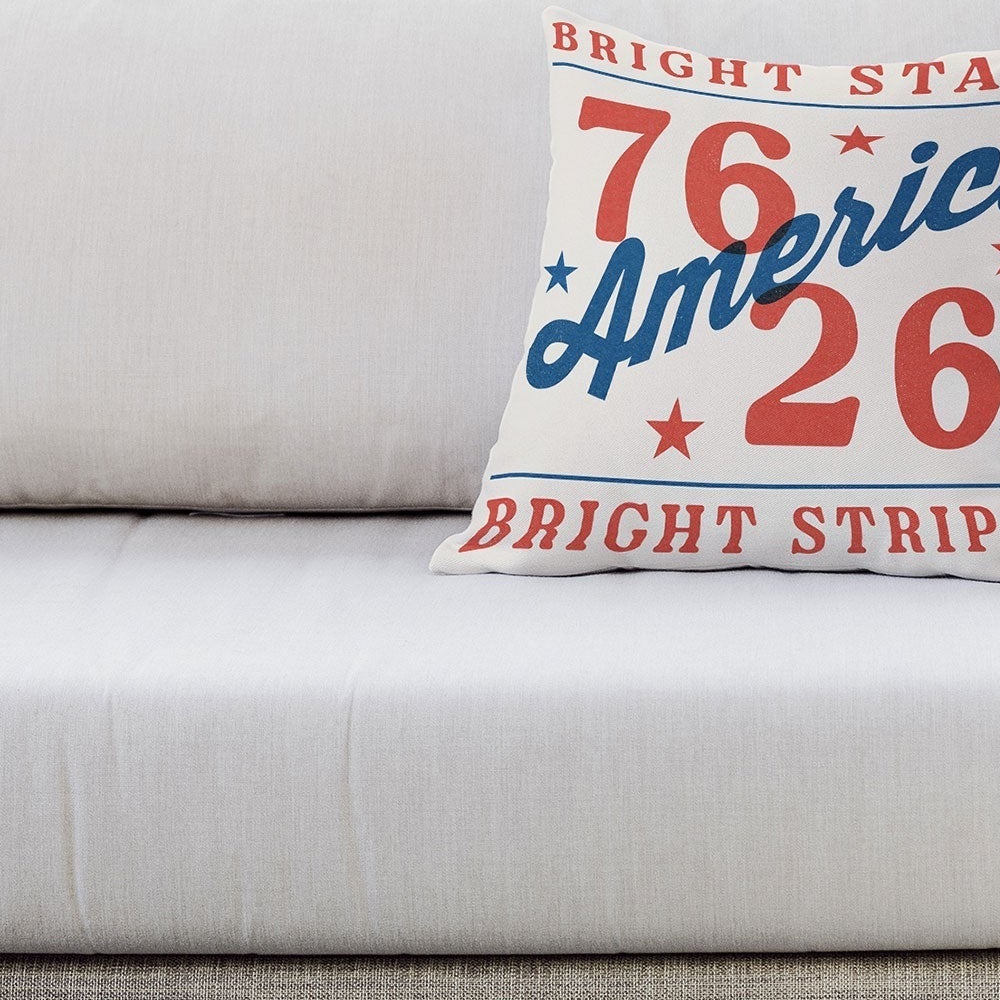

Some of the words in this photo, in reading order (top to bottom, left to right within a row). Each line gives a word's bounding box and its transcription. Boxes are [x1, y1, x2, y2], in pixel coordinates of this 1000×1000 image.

[552, 21, 802, 92] BRIGHT
[577, 95, 797, 255] 76
[458, 497, 757, 554] BRIGHT
